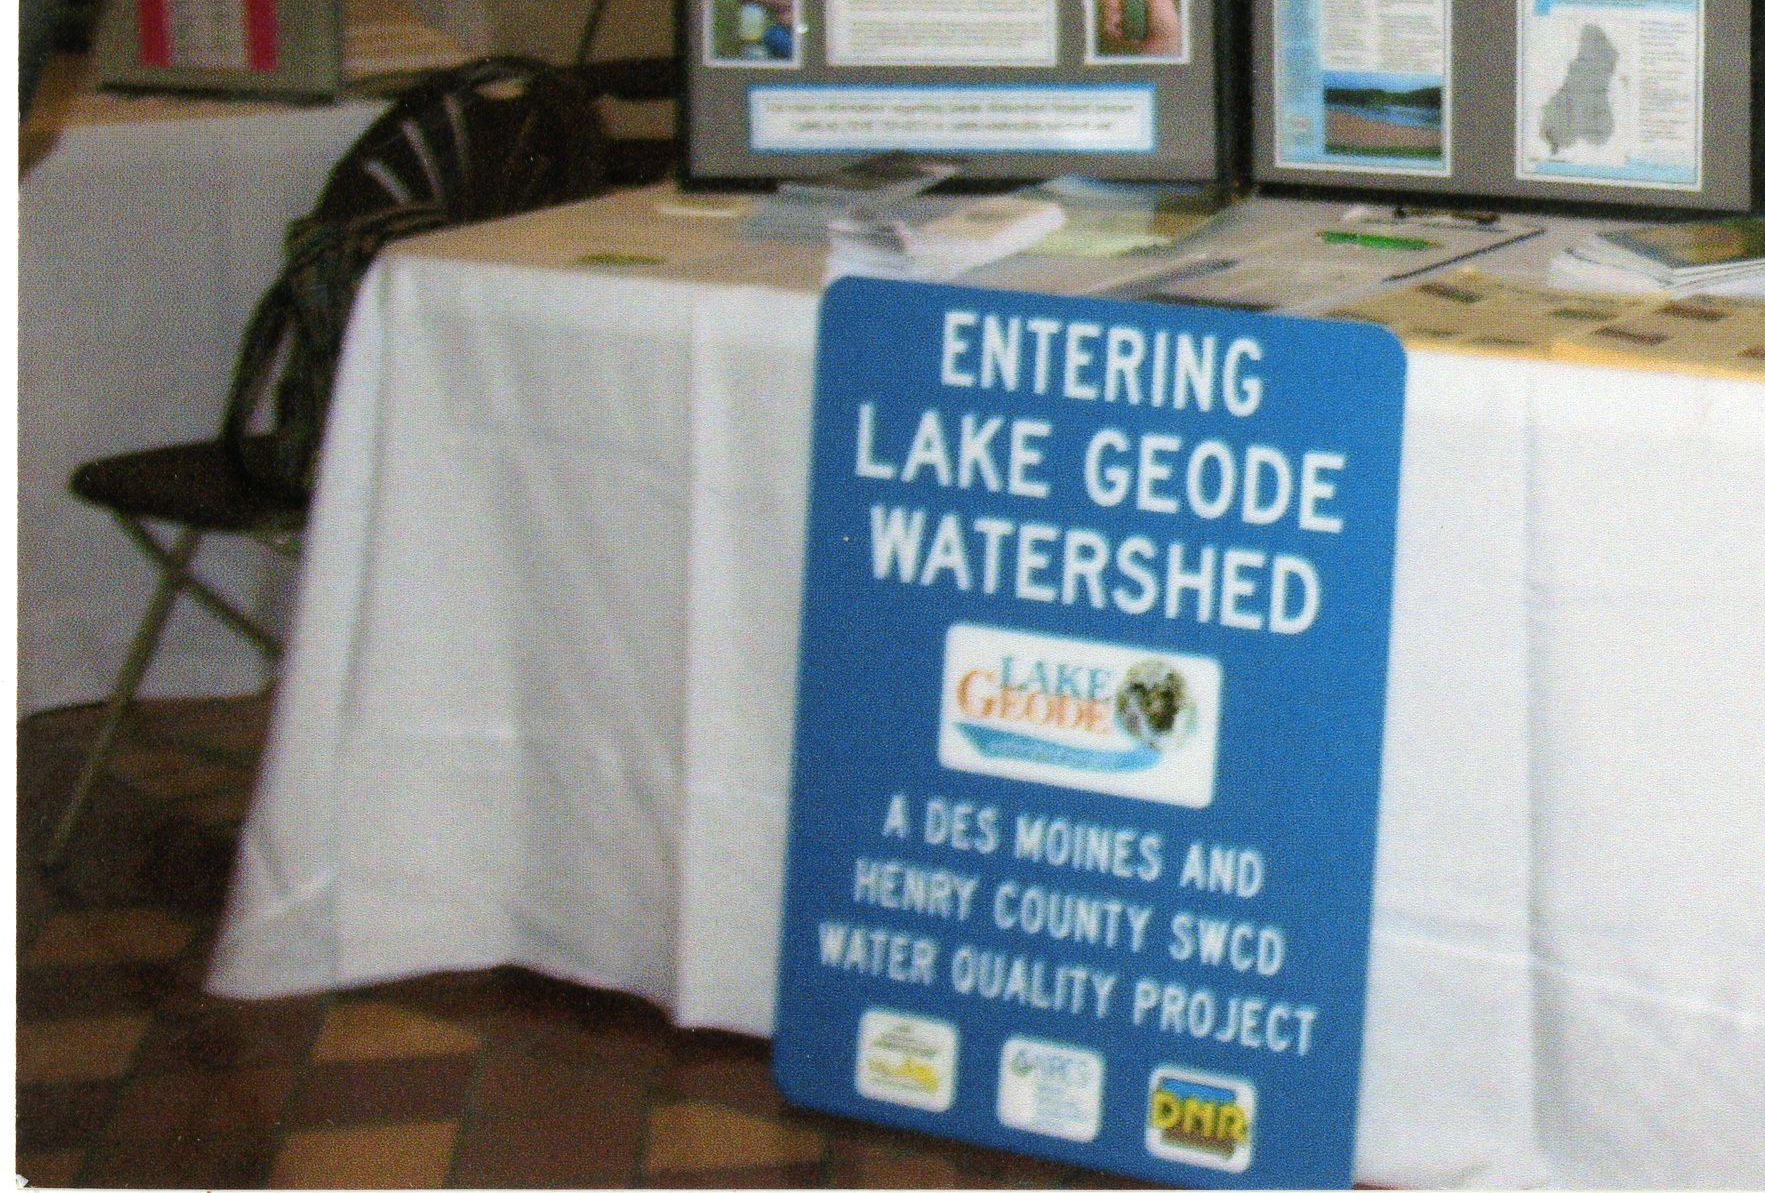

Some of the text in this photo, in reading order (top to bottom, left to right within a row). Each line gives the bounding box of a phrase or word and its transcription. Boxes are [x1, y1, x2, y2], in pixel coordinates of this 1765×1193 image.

[940, 310, 1265, 418] ENTERING
[855, 402, 1347, 533] LAKE GEODE
[870, 505, 1323, 635] WATERSHED
[999, 655, 1112, 702] LAKE
[882, 794, 1265, 898] A DES MOINES AND
[853, 857, 1286, 976] HENRY COUNTY SWCD
[819, 922, 1318, 1057] WATER QUALITY PROJECT
[1152, 1091, 1247, 1144] DNR
